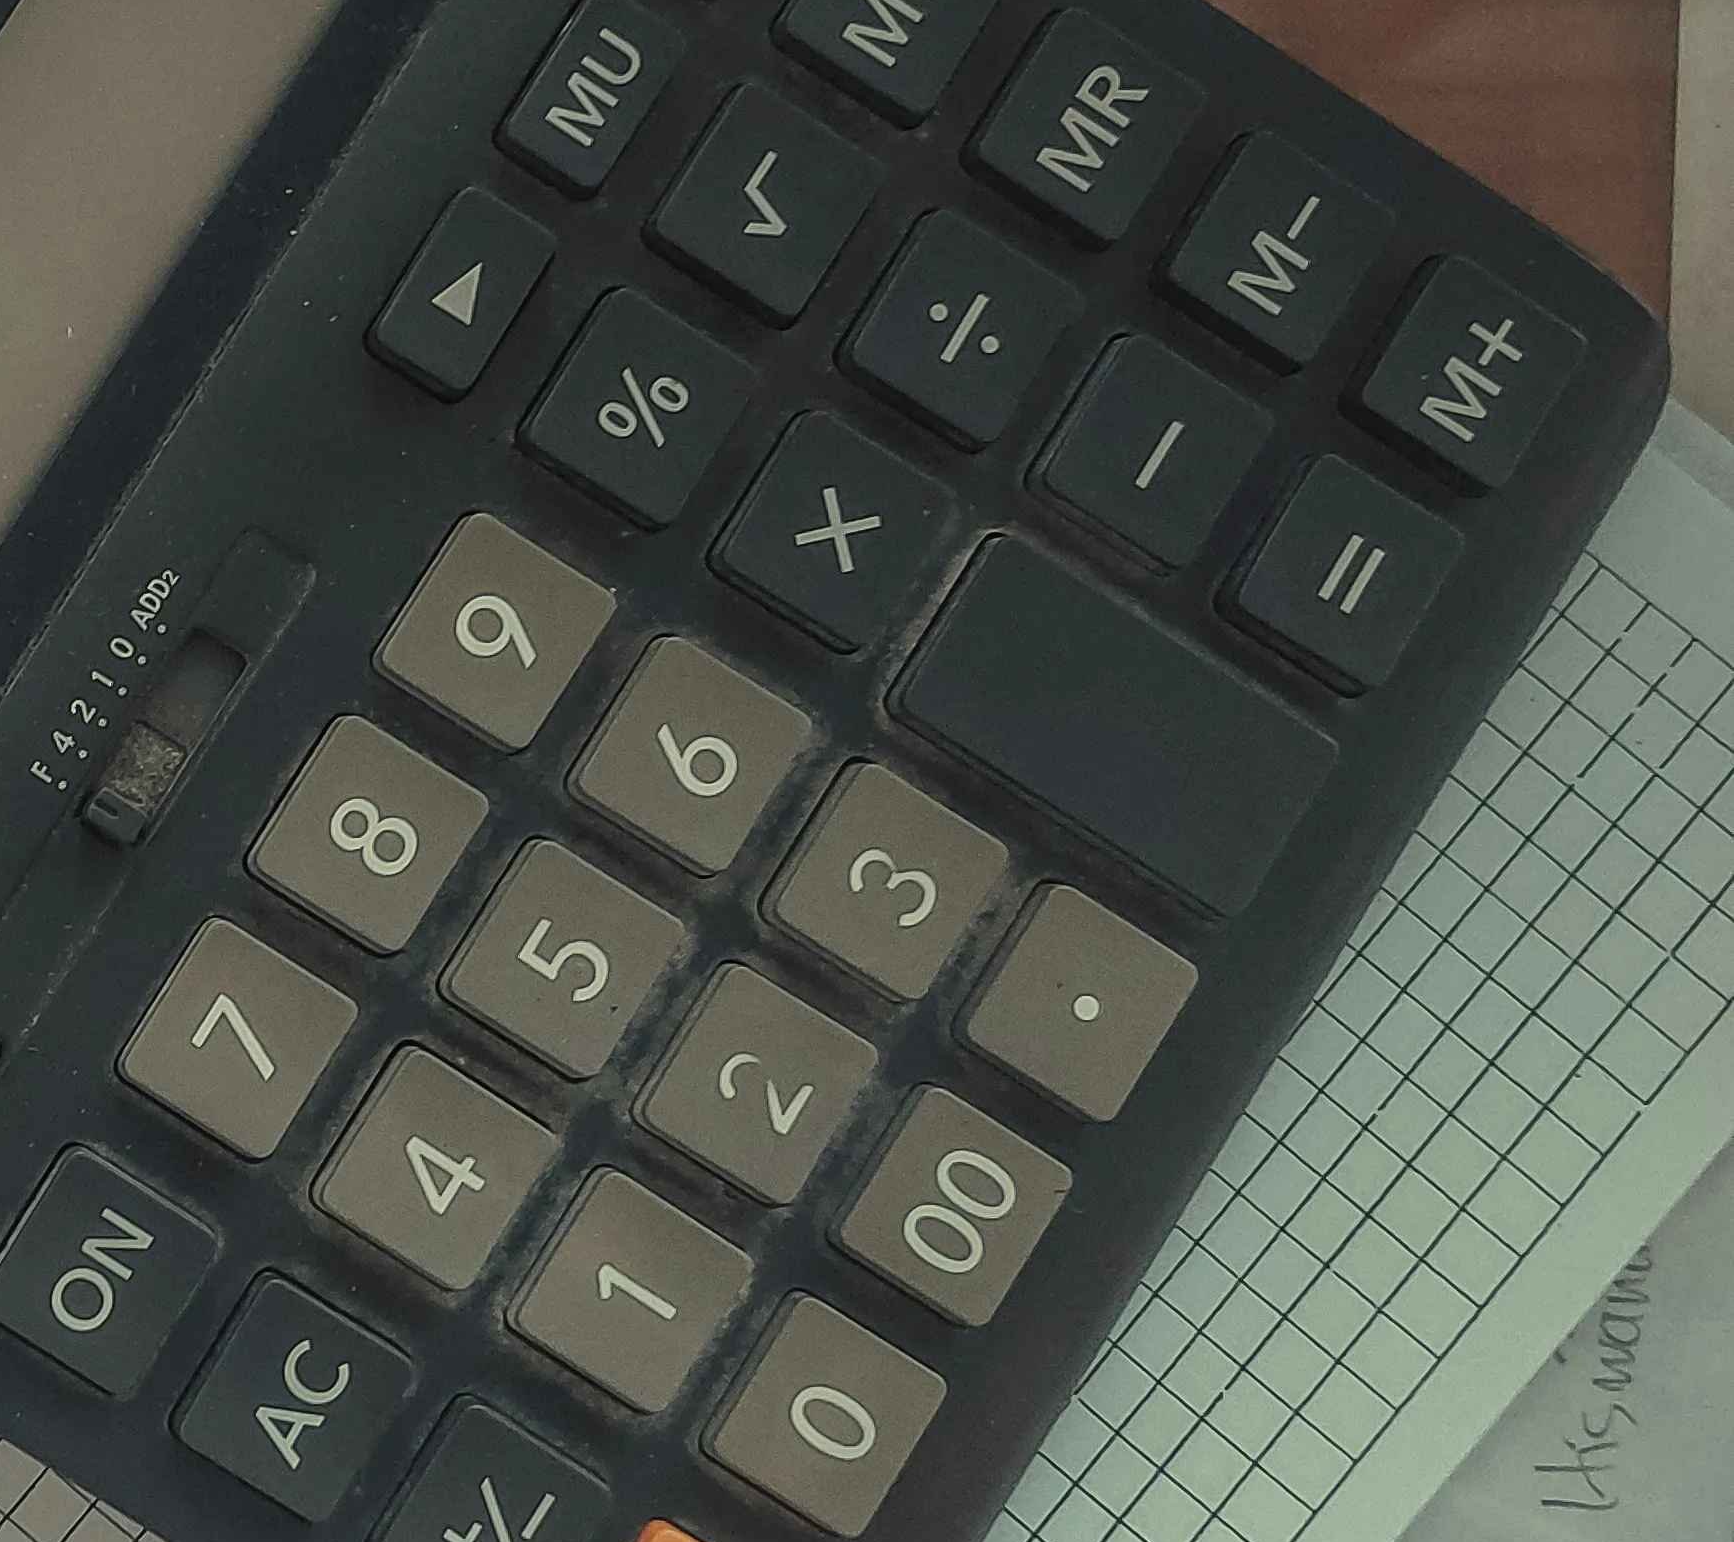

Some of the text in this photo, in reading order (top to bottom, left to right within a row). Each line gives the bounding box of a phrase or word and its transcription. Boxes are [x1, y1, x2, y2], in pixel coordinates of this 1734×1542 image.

[545, 28, 642, 147] MU
[1036, 64, 1150, 194] MR
[597, 367, 690, 448] %
[1419, 317, 1523, 443] M+
[454, 594, 538, 670] 9
[29, 759, 53, 785] F
[51, 730, 76, 754] 4
[69, 698, 98, 724] 2
[91, 668, 115, 690] 1
[109, 636, 134, 660] 0
[657, 723, 738, 797] 6
[329, 797, 418, 876] 8
[848, 848, 937, 928] 3
[517, 917, 611, 1003] 5
[192, 993, 276, 1081] 7
[718, 1052, 815, 1136] 2
[404, 1133, 487, 1216] 4
[902, 1149, 1017, 1274] 00
[50, 1205, 156, 1333] ON
[596, 1263, 677, 1320] 1
[253, 1337, 352, 1471] AC
[787, 1385, 878, 1462] 0
